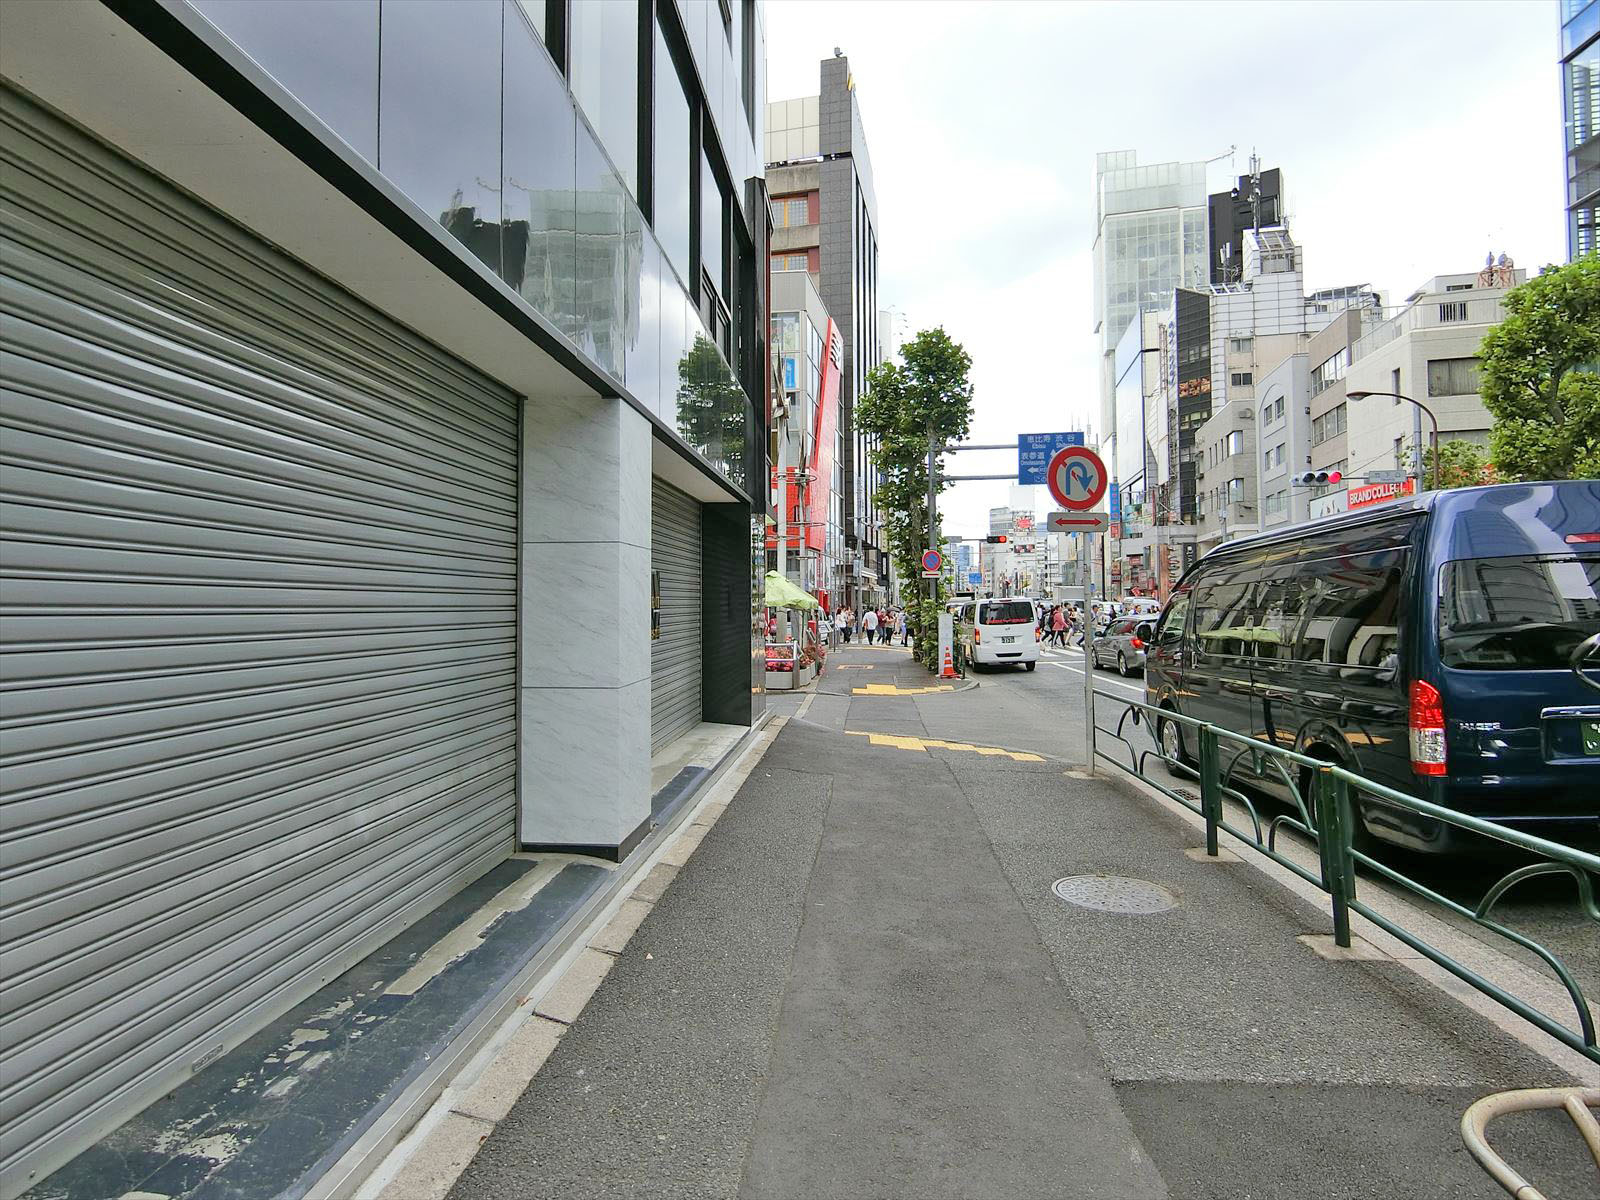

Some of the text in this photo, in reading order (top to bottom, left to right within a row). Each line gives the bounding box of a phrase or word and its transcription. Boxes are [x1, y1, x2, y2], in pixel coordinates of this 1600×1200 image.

[1027, 434, 1075, 443] 恵比寿 渋谷
[1021, 451, 1045, 460] 表参道
[1349, 490, 1372, 504] BRAND
